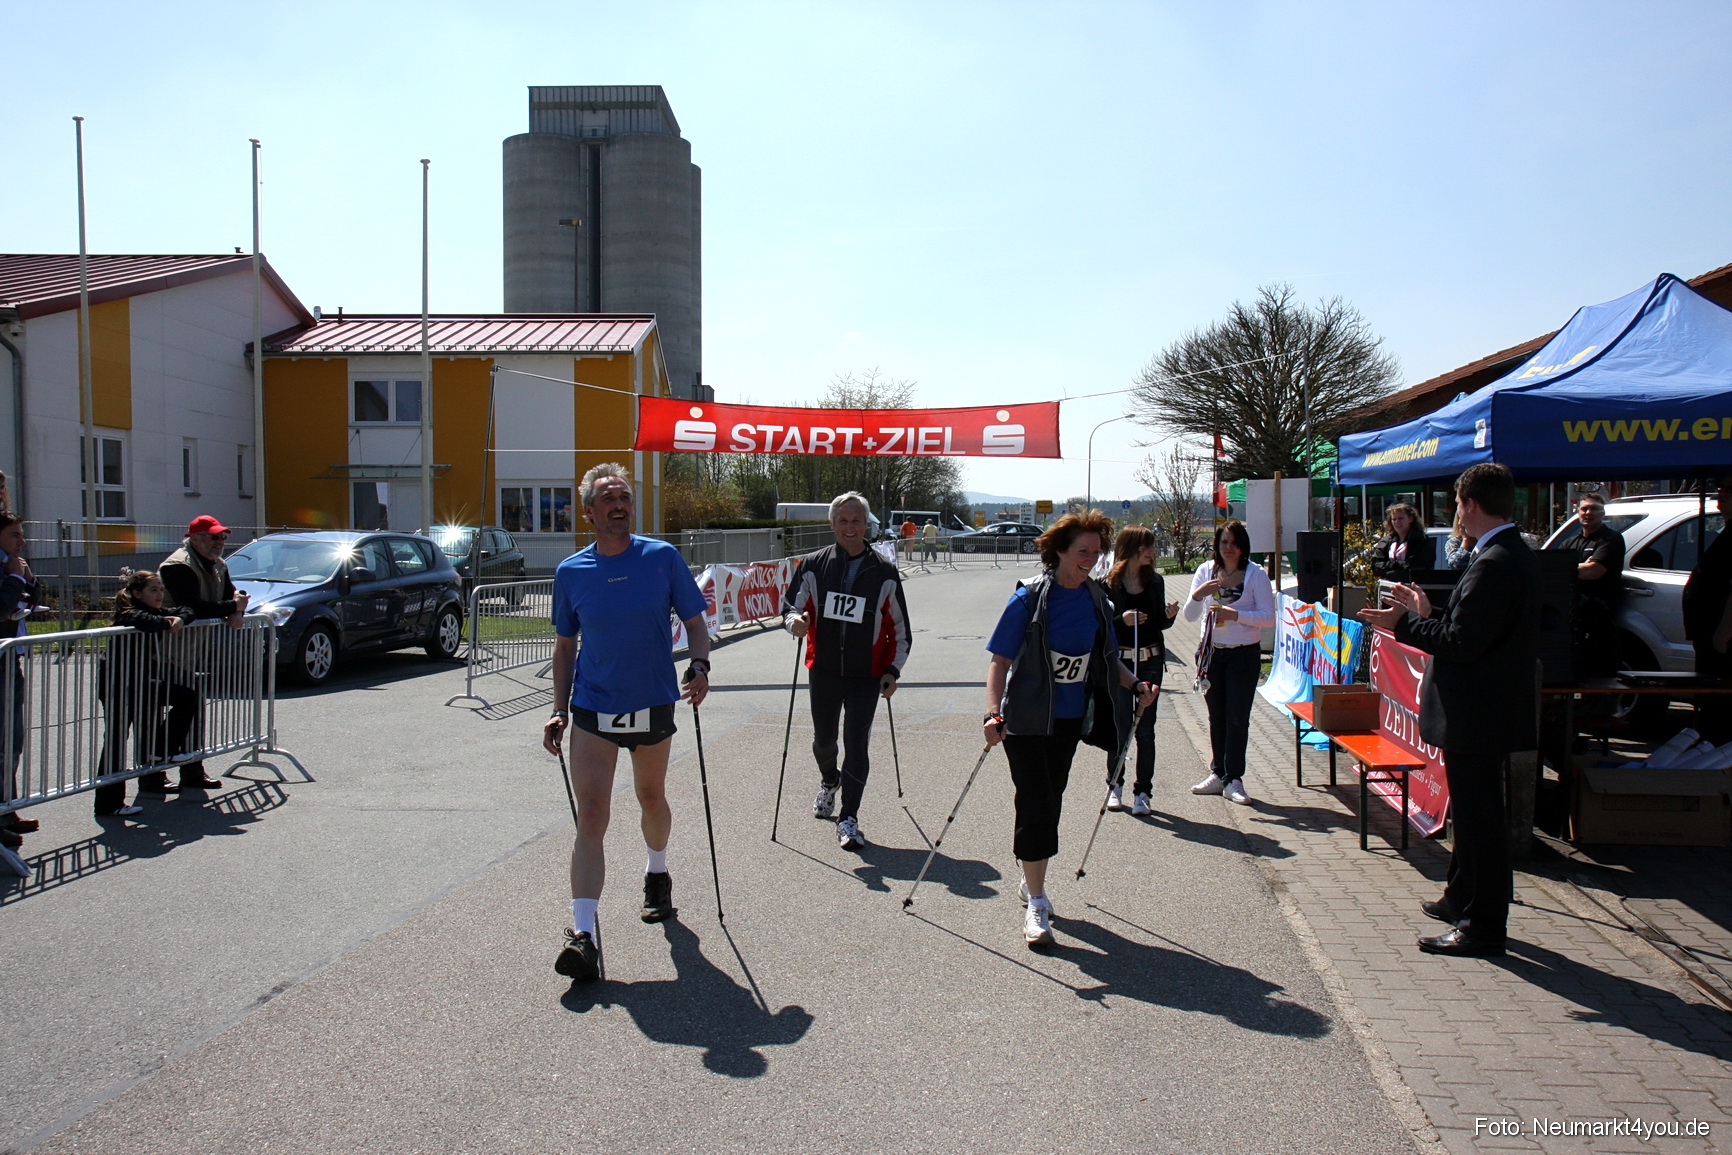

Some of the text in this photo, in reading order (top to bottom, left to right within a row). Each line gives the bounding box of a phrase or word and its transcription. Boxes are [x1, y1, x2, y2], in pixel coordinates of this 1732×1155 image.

[833, 595, 857, 618] 112
[1054, 656, 1083, 680] 26
[1382, 693, 1445, 767] ZEITL
